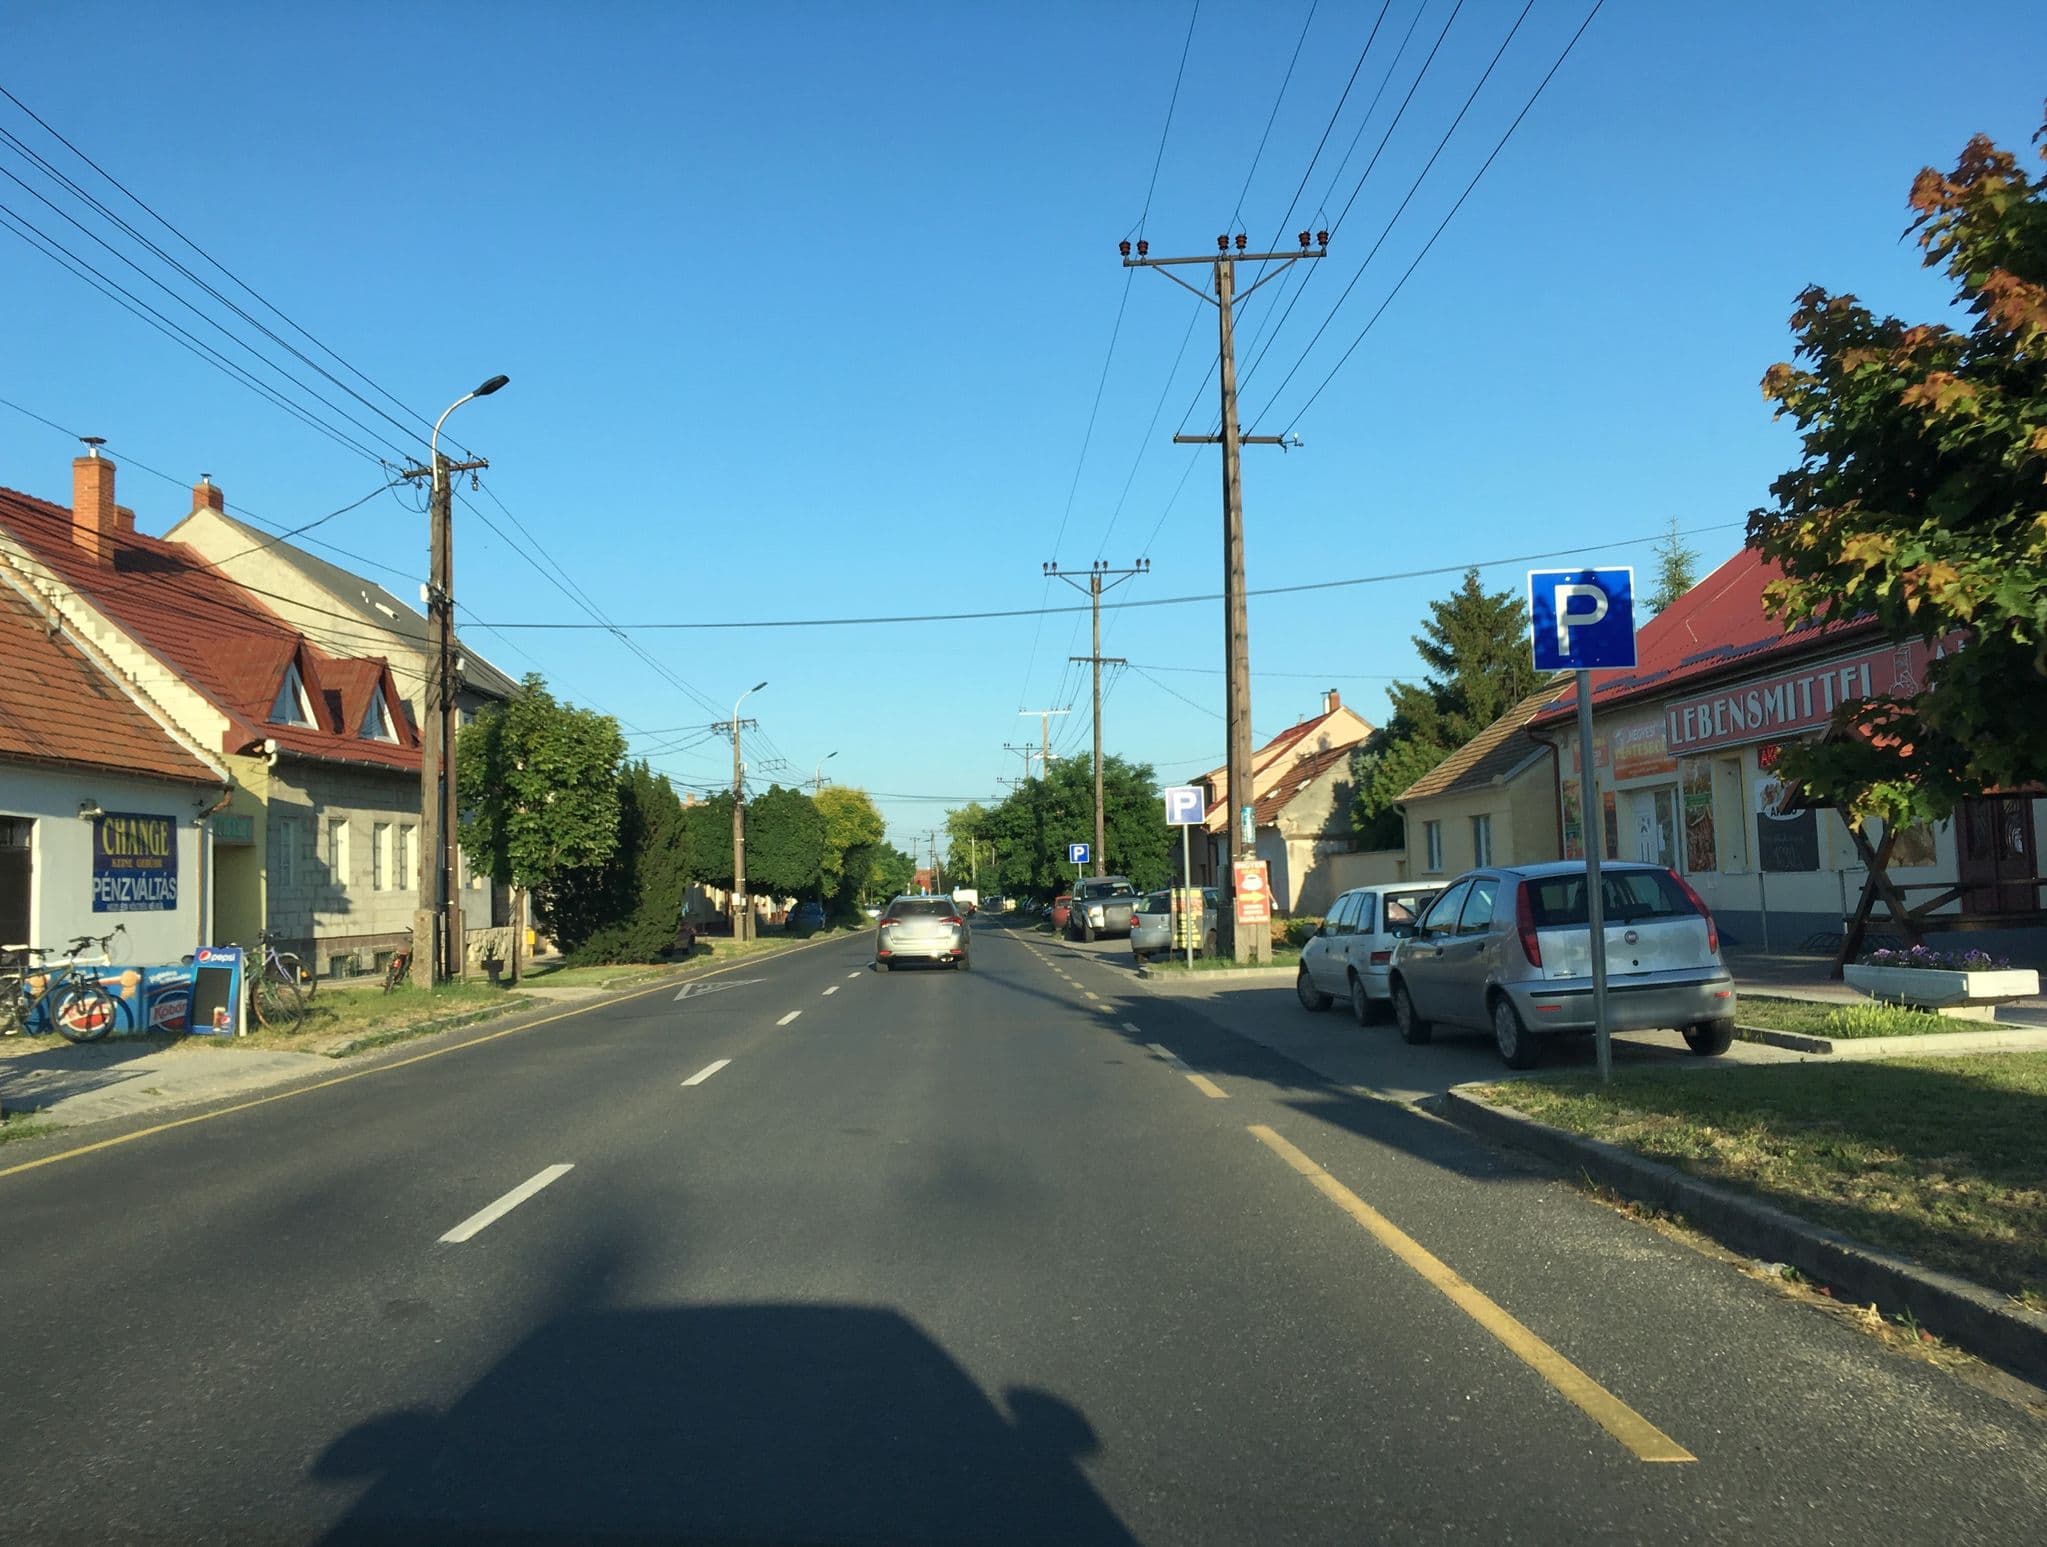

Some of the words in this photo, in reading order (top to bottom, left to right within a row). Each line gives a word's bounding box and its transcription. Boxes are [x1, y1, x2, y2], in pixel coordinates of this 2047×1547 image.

[1555, 584, 1608, 656] P
[1172, 791, 1197, 820] P
[102, 817, 169, 856] CHANGE
[1073, 847, 1085, 861] P
[93, 871, 177, 902] PÉNZVÁLTÁS
